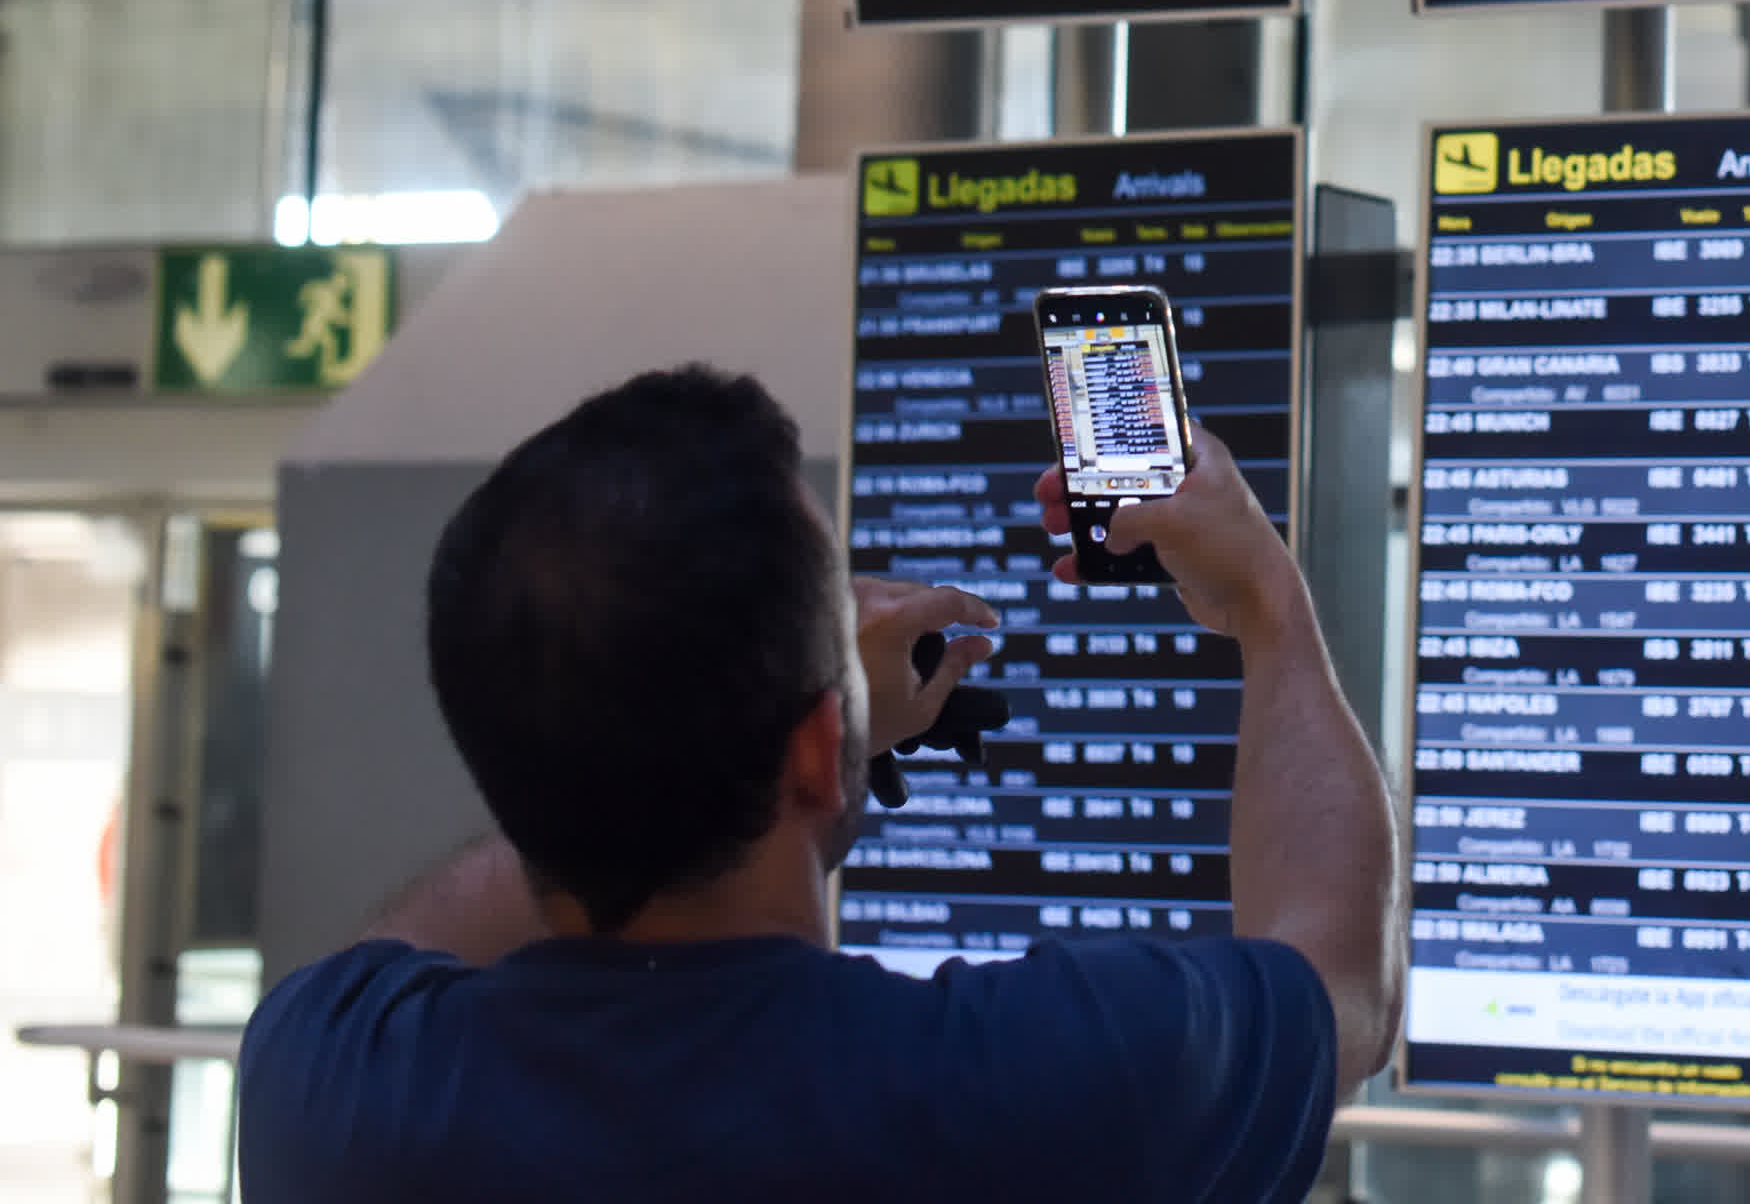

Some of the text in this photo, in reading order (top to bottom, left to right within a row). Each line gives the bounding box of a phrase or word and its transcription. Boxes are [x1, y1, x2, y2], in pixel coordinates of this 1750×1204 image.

[1508, 145, 1676, 190] Llegadas
[928, 170, 1205, 211] Llegadas Arrivals
